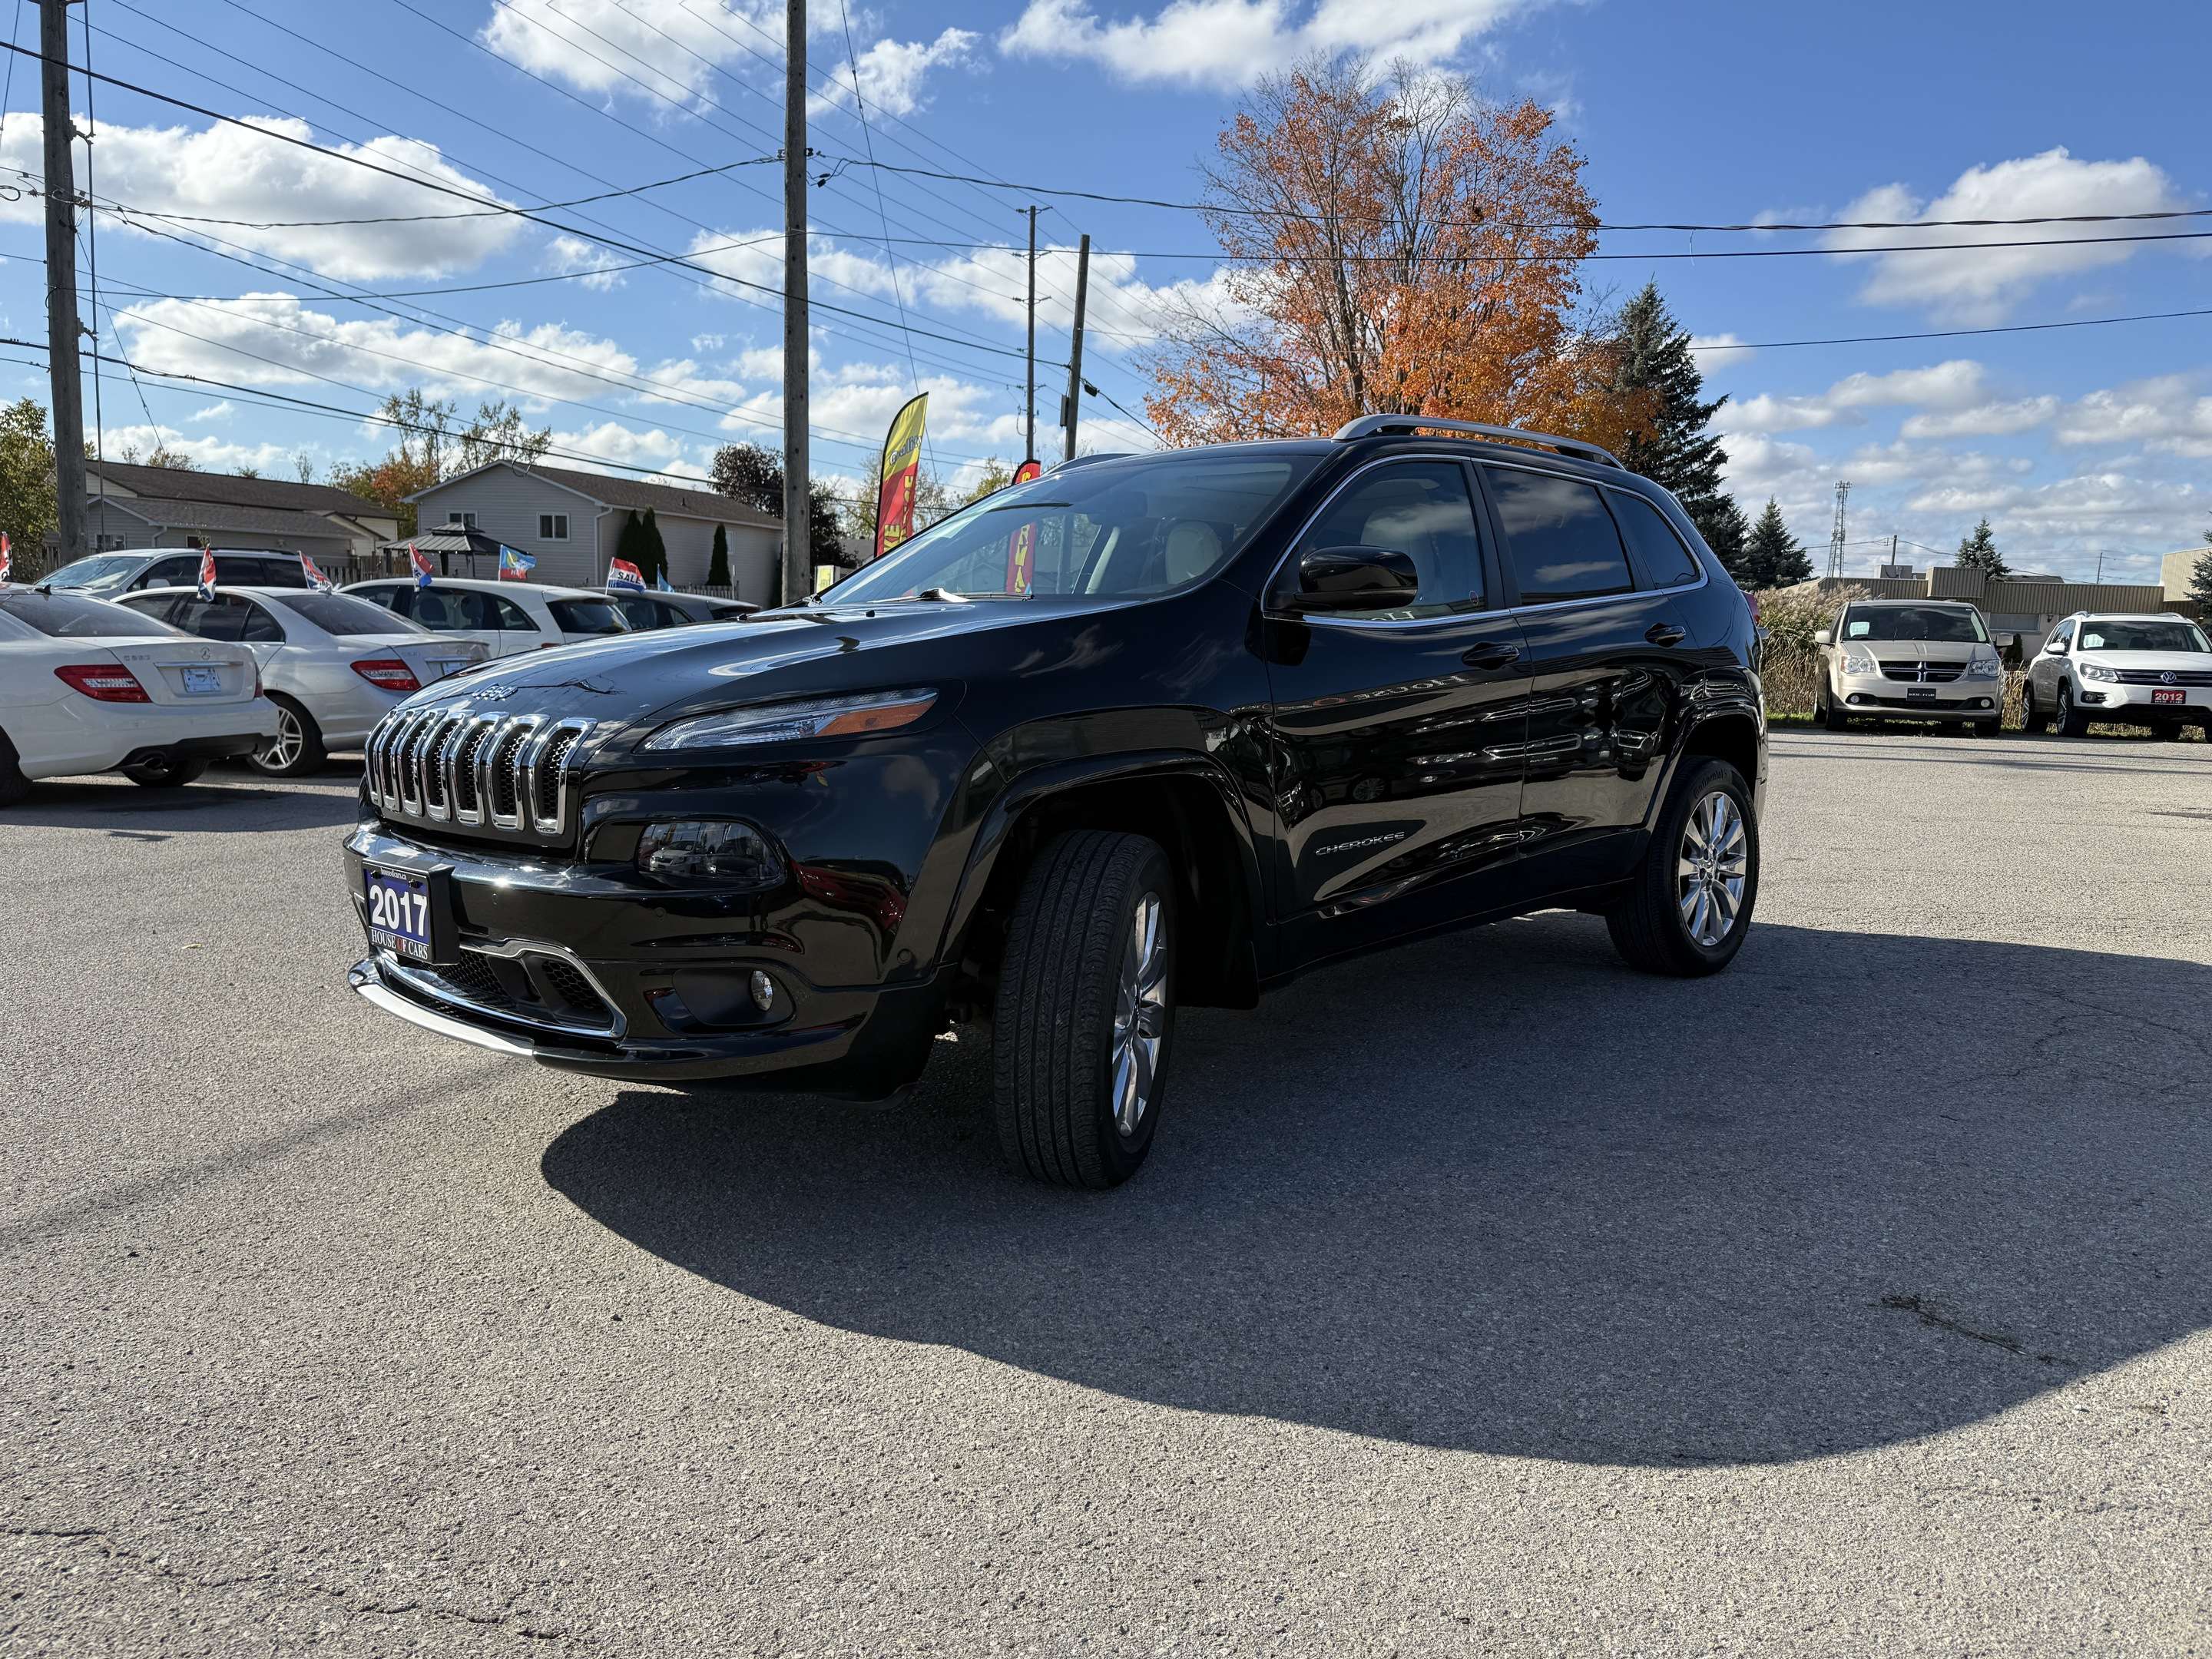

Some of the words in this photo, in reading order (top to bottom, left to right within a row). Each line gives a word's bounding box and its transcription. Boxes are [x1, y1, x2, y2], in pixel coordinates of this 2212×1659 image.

[618, 571, 641, 584] SALE
[2155, 693, 2183, 701] 2012
[1316, 831, 1405, 856] CHEROKEE
[369, 885, 427, 936] 2017
[371, 929, 396, 949] HOUSE
[396, 936, 407, 952] OF
[408, 941, 428, 959] CARS
